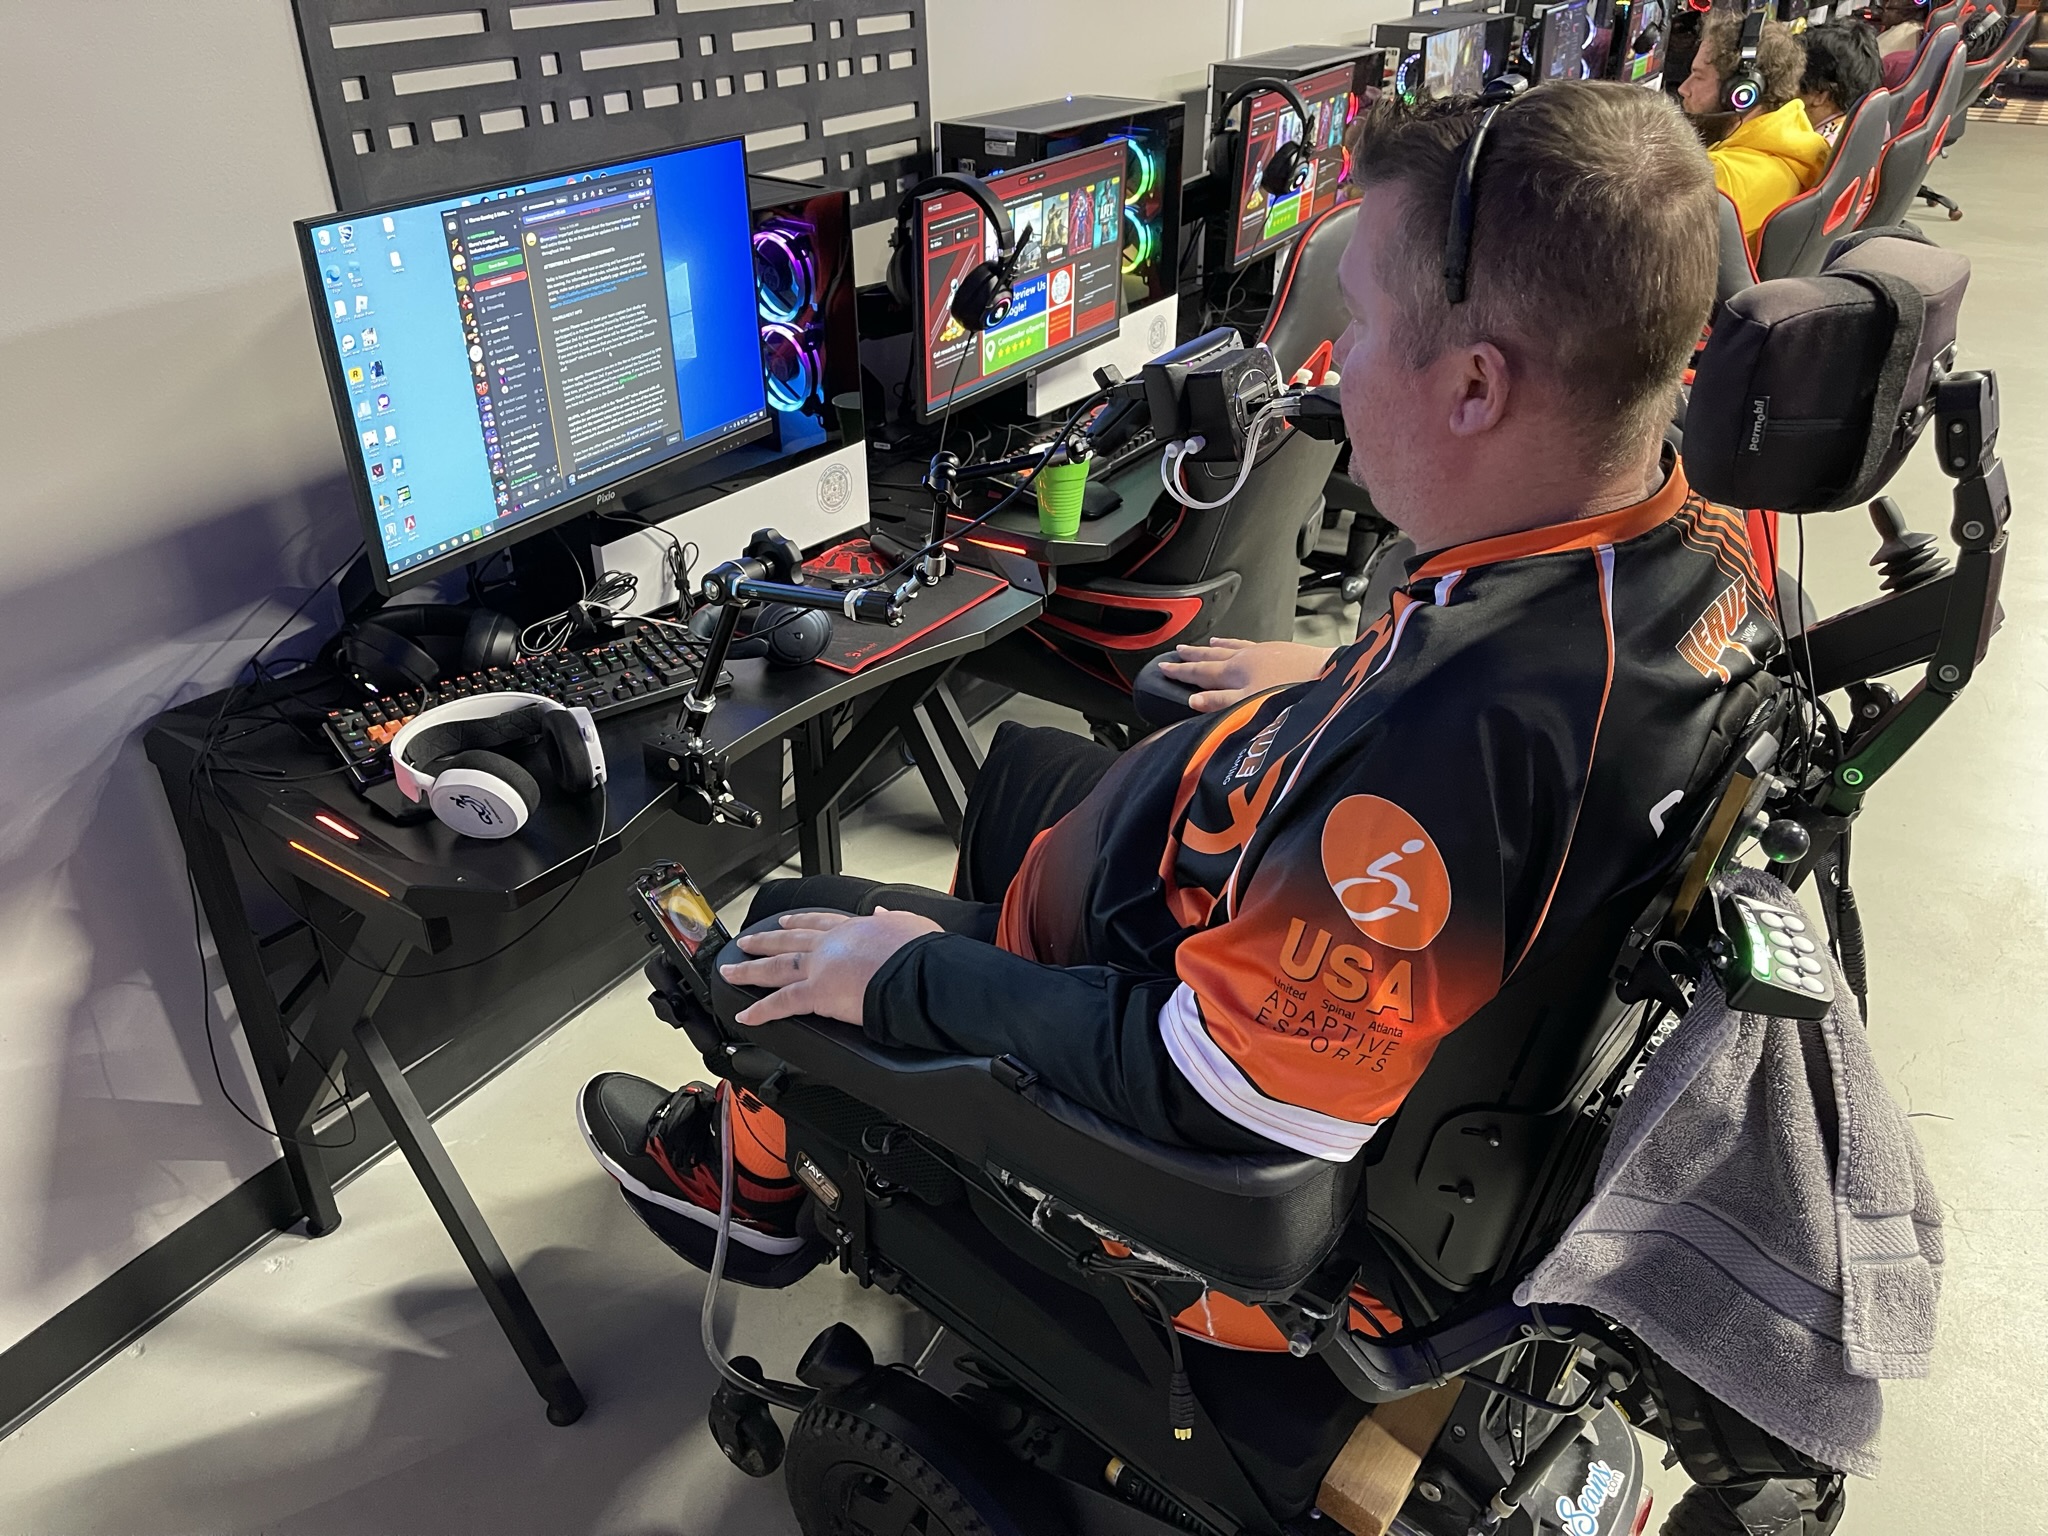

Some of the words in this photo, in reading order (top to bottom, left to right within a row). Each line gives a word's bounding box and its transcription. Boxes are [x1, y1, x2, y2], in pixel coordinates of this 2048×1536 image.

[1006, 299, 1027, 317] ogle!
[1036, 280, 1046, 292] Us
[1749, 400, 1765, 451] permobil
[596, 490, 616, 505] Pixio
[1235, 704, 1291, 778] RVE
[1279, 917, 1414, 1022] USA
[1264, 989, 1400, 1056] ADAPTIVE
[1274, 976, 1307, 1000] United
[1320, 999, 1356, 1020] Spinal
[1368, 1021, 1403, 1038] Atlanta
[1255, 1006, 1388, 1073] ESPORTS
[803, 1160, 823, 1179] JAY
[1558, 1461, 1612, 1536] Seans
